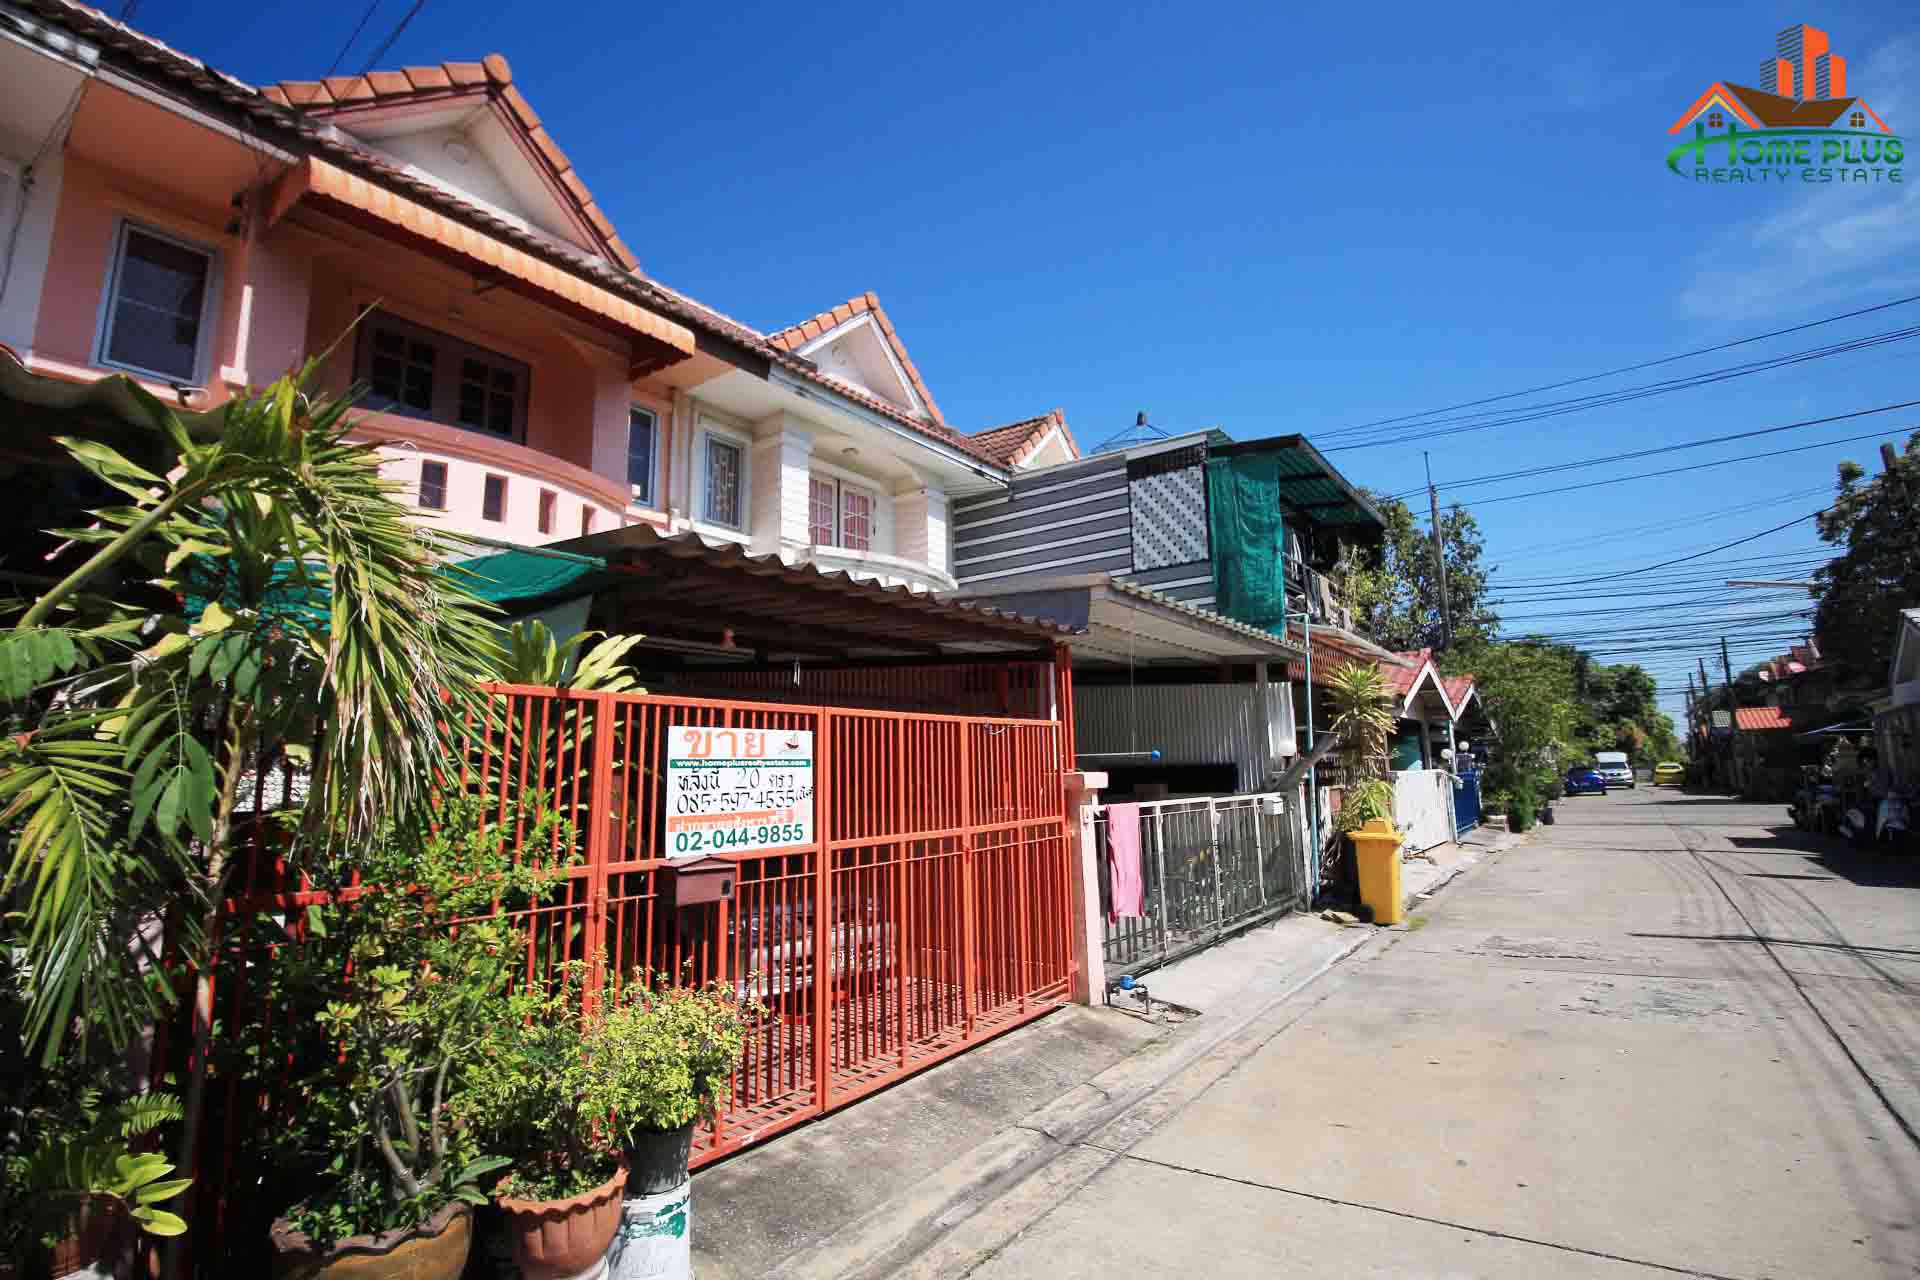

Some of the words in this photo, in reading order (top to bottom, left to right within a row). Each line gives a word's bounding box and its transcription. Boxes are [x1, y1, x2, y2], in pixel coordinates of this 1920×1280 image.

[683, 729, 768, 758] ขาย
[735, 768, 760, 789] 20
[675, 823, 804, 852] 02-044-9855
